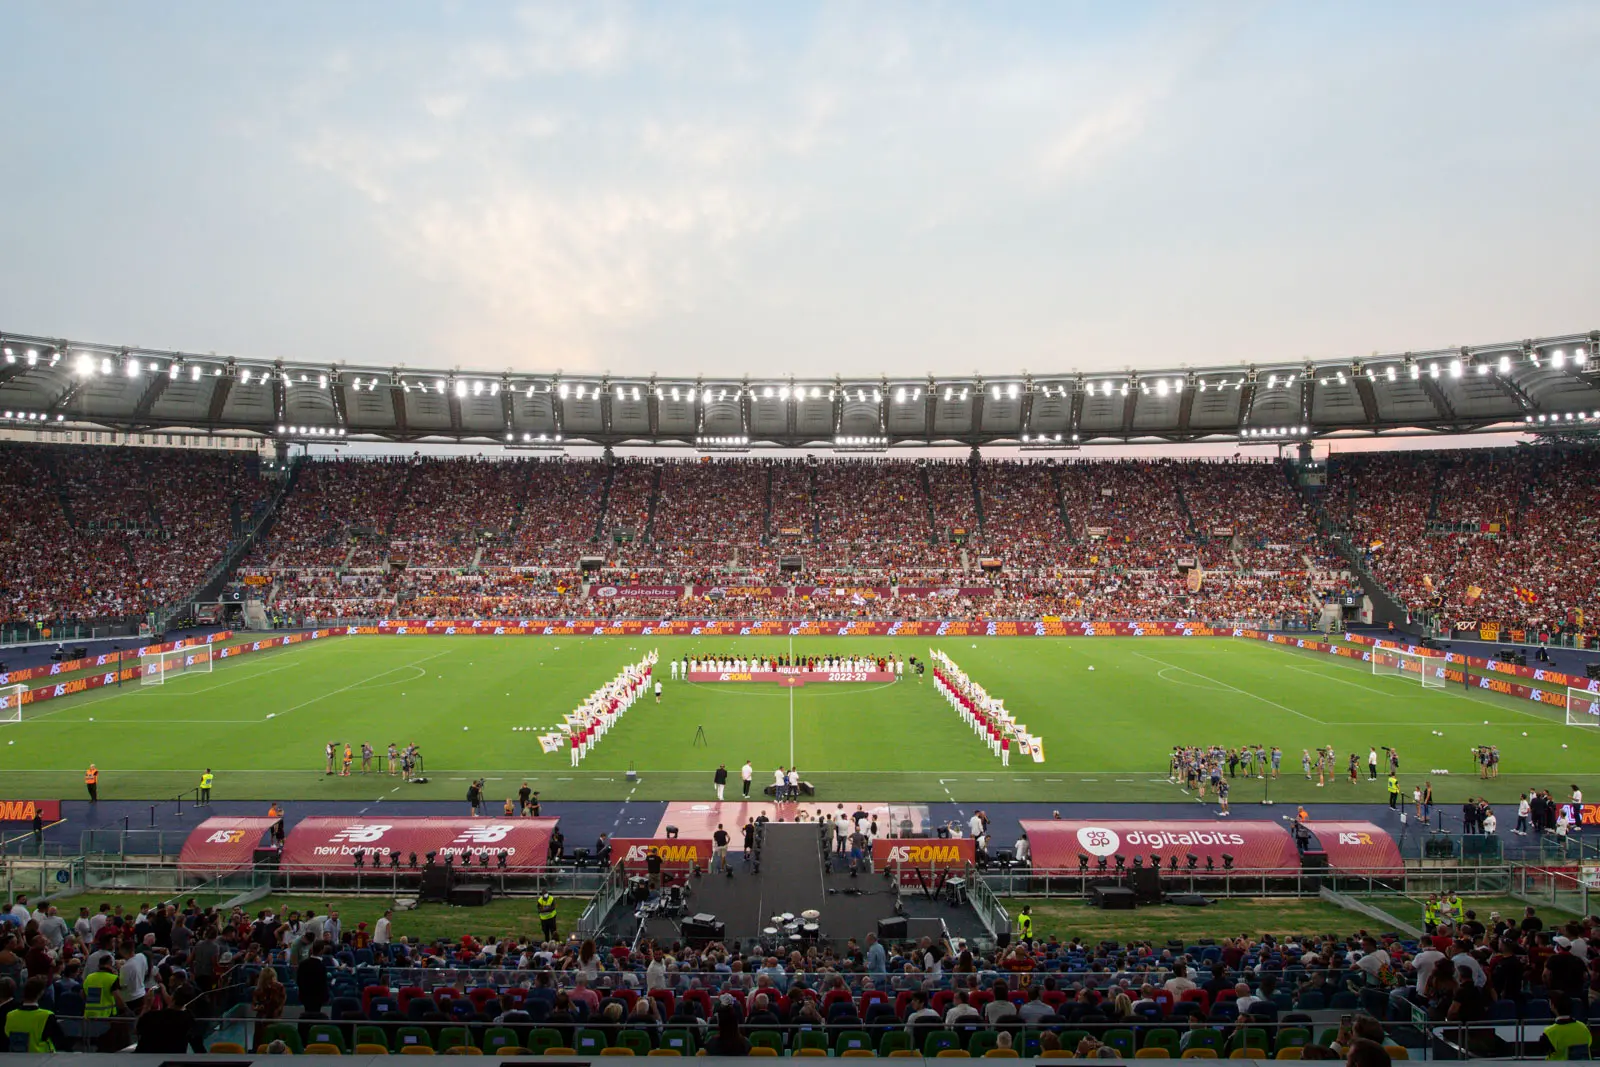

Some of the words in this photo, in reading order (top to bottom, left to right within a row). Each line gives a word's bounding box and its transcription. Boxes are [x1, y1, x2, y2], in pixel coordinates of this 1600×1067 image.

[233, 592, 240, 600] C
[620, 588, 676, 596] digitalbits
[50, 660, 81, 676] ASROMA
[1486, 660, 1516, 676] ASROMA
[720, 672, 752, 680] ASROMA
[828, 672, 868, 681] 2022-23
[1534, 669, 1568, 686] ASROMA
[54, 678, 87, 697] ASROMA
[1480, 677, 1512, 695] ASROMA
[1530, 688, 1566, 708] ASROMA
[205, 830, 246, 843] ASR
[1126, 831, 1244, 849] digitalbits
[1339, 832, 1374, 845] ASR
[314, 846, 340, 855] new
[340, 844, 390, 856] balance
[439, 846, 464, 856] new
[466, 844, 516, 856] balance
[886, 845, 960, 863] ASROMA
